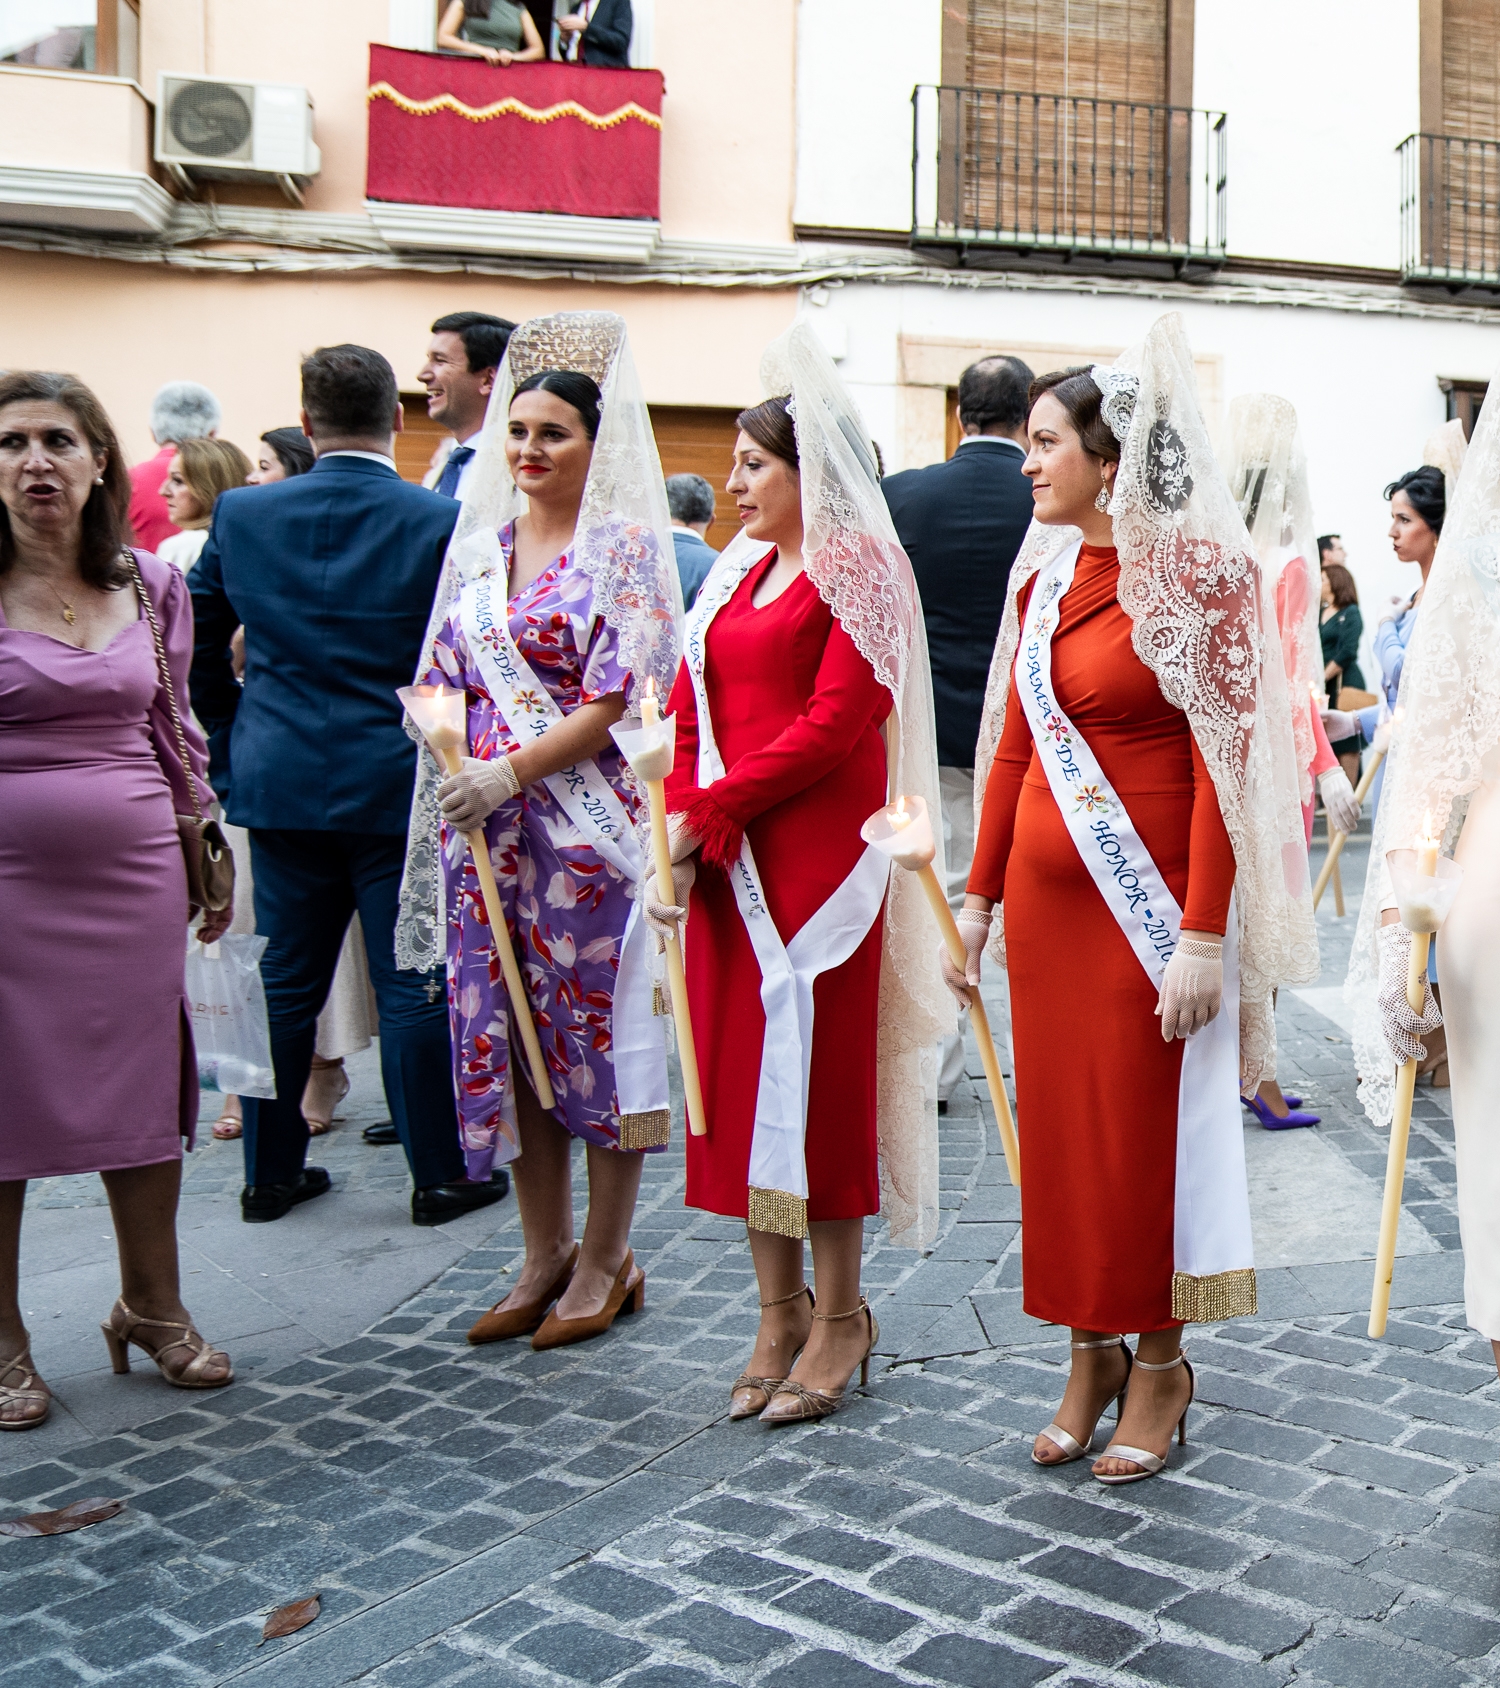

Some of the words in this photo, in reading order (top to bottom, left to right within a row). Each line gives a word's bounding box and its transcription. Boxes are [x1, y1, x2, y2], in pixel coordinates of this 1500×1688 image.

[476, 584, 494, 633] DAMA
[493, 653, 520, 684] DE
[1027, 642, 1052, 720] DAMA
[1056, 744, 1082, 782] DE
